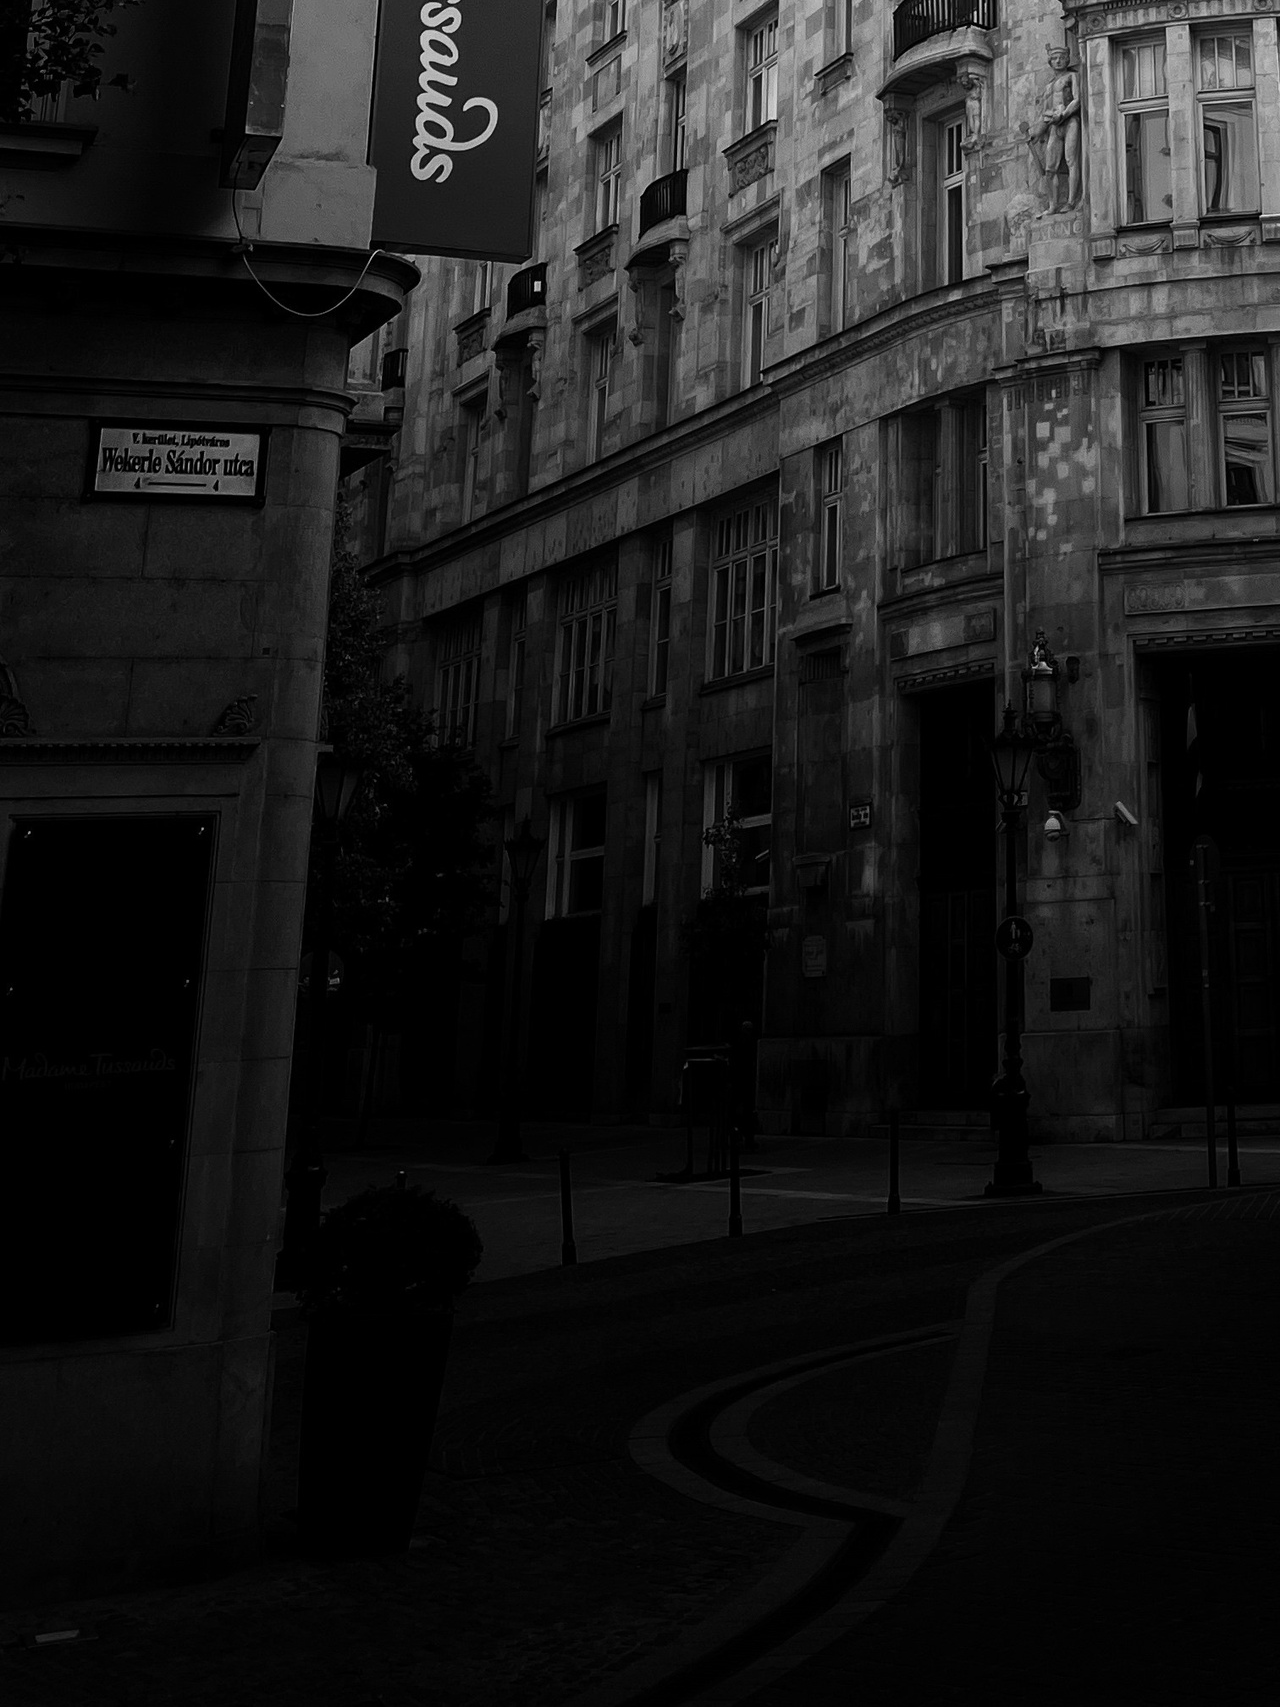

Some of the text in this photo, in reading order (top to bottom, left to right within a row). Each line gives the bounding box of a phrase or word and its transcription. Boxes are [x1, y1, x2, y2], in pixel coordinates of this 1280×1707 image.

[101, 447, 255, 476] Wekerle Sándor utca
[1, 1048, 177, 1082] Madame Tussauds
